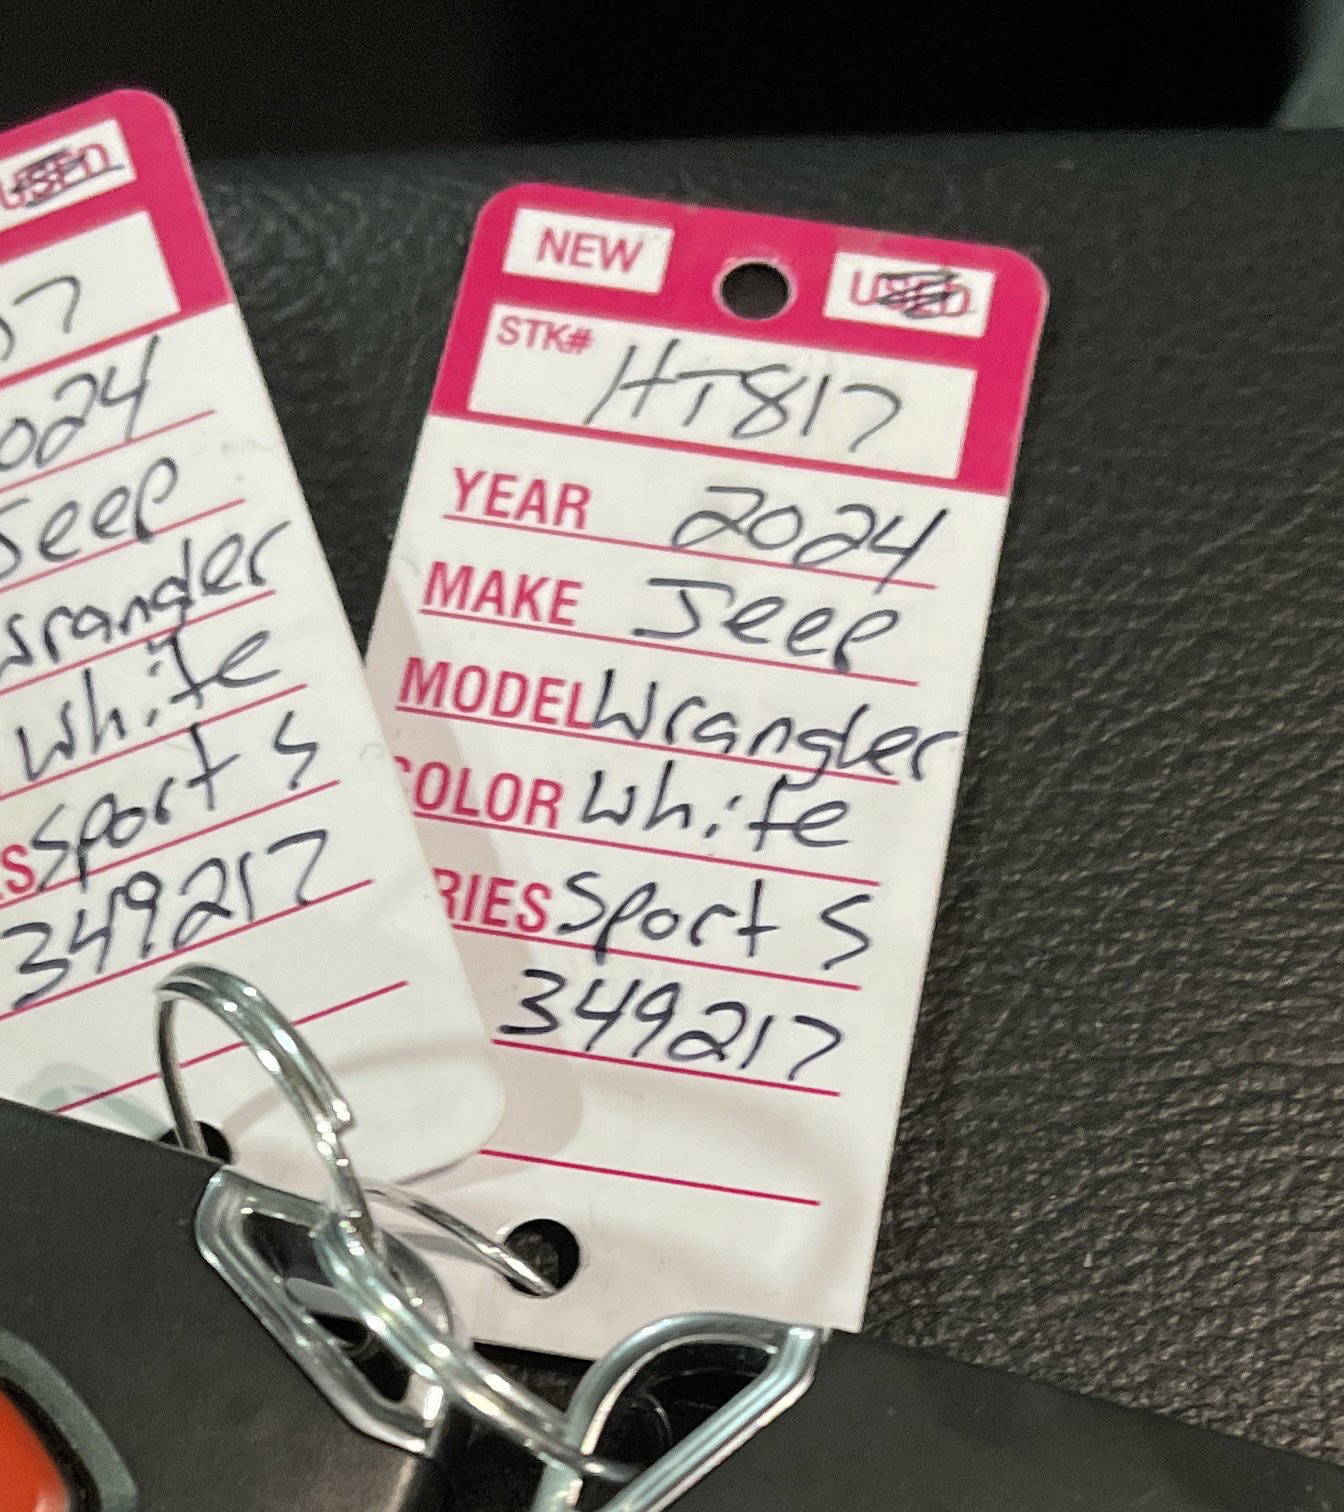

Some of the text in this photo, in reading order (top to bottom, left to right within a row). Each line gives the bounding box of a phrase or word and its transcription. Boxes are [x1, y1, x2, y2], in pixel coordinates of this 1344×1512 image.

[535, 228, 644, 273] NEW
[496, 316, 901, 452] STK# HT817
[453, 467, 948, 595] YEAR 2024
[423, 561, 899, 674] MAKE Jeep
[397, 657, 962, 792] MODEL Wrangler
[2, 830, 327, 1010] 349217
[432, 867, 553, 933] RIES
[499, 969, 845, 1081] 349217
